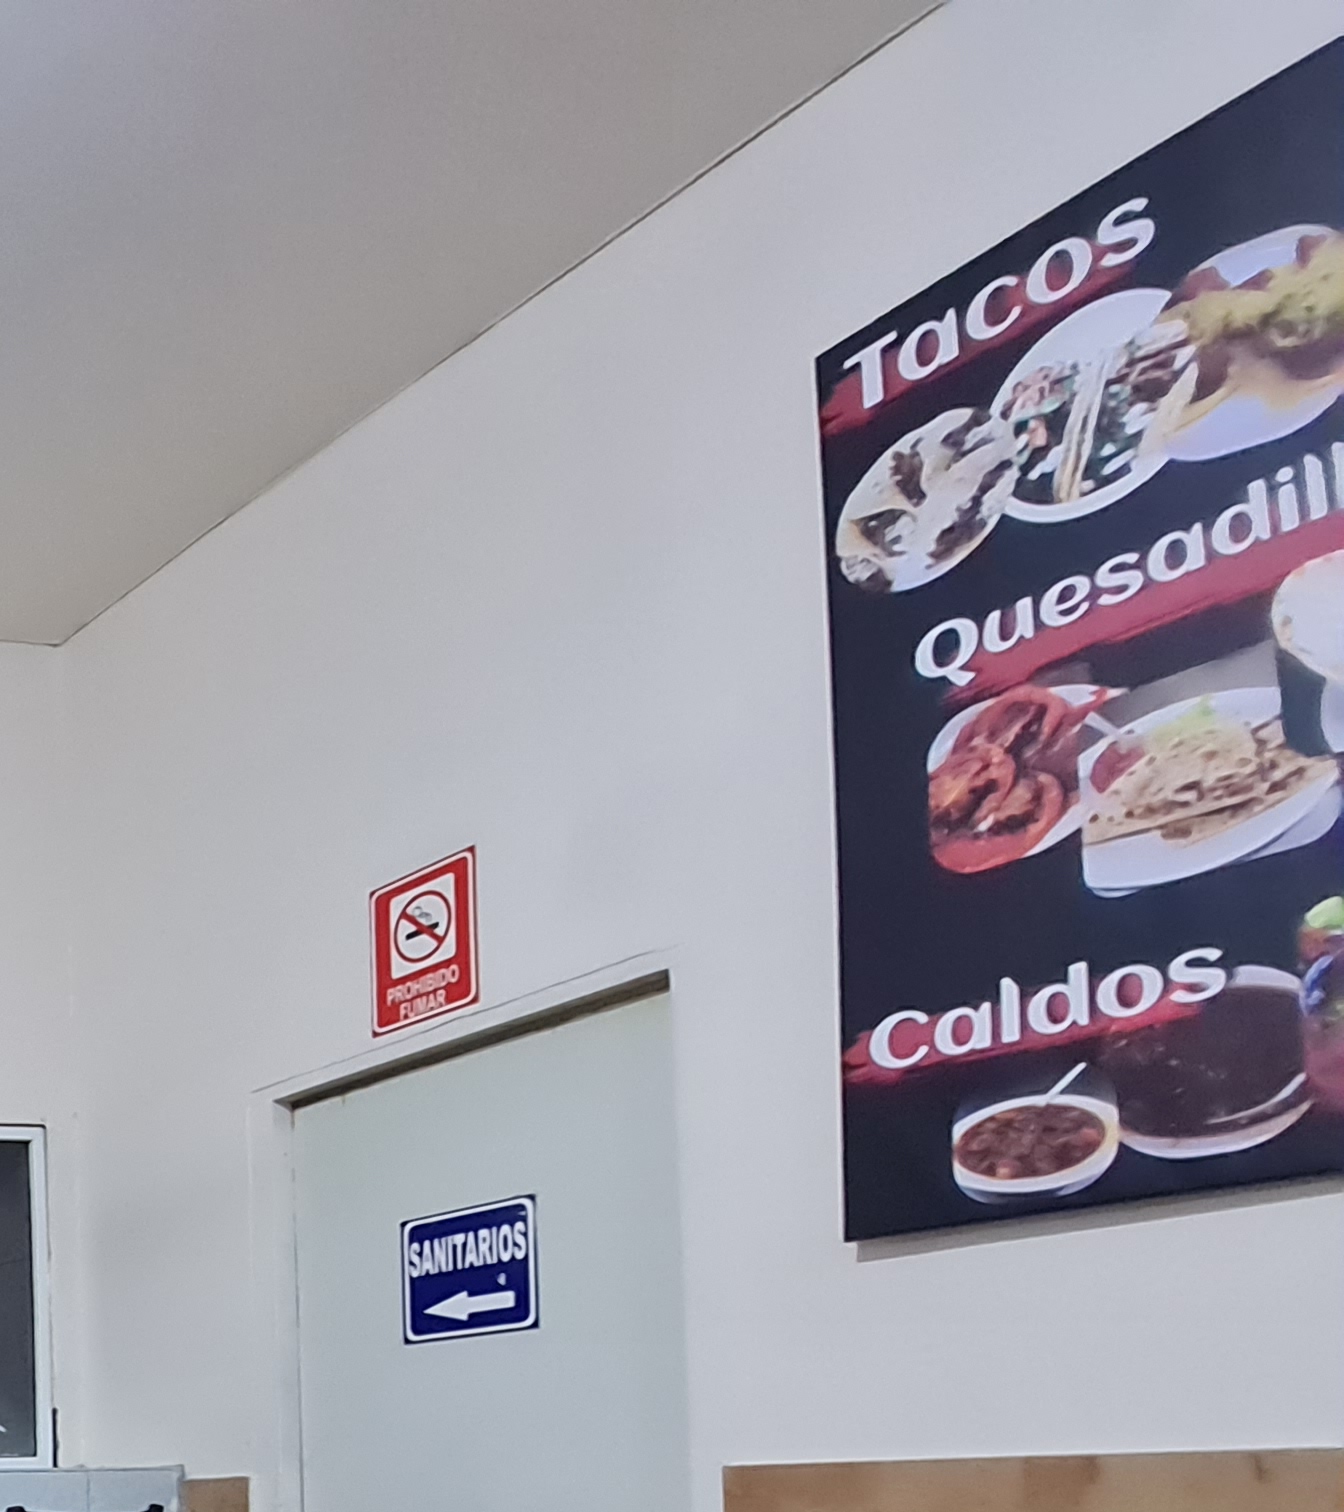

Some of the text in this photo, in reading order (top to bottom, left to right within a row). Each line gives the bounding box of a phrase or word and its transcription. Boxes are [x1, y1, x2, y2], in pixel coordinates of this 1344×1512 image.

[842, 196, 1156, 411] Tacos
[386, 964, 460, 1007] PROHIBIDO
[399, 989, 447, 1020] FUMAR
[868, 946, 1229, 1070] Caldos
[408, 1220, 528, 1279] SANITARIOS
